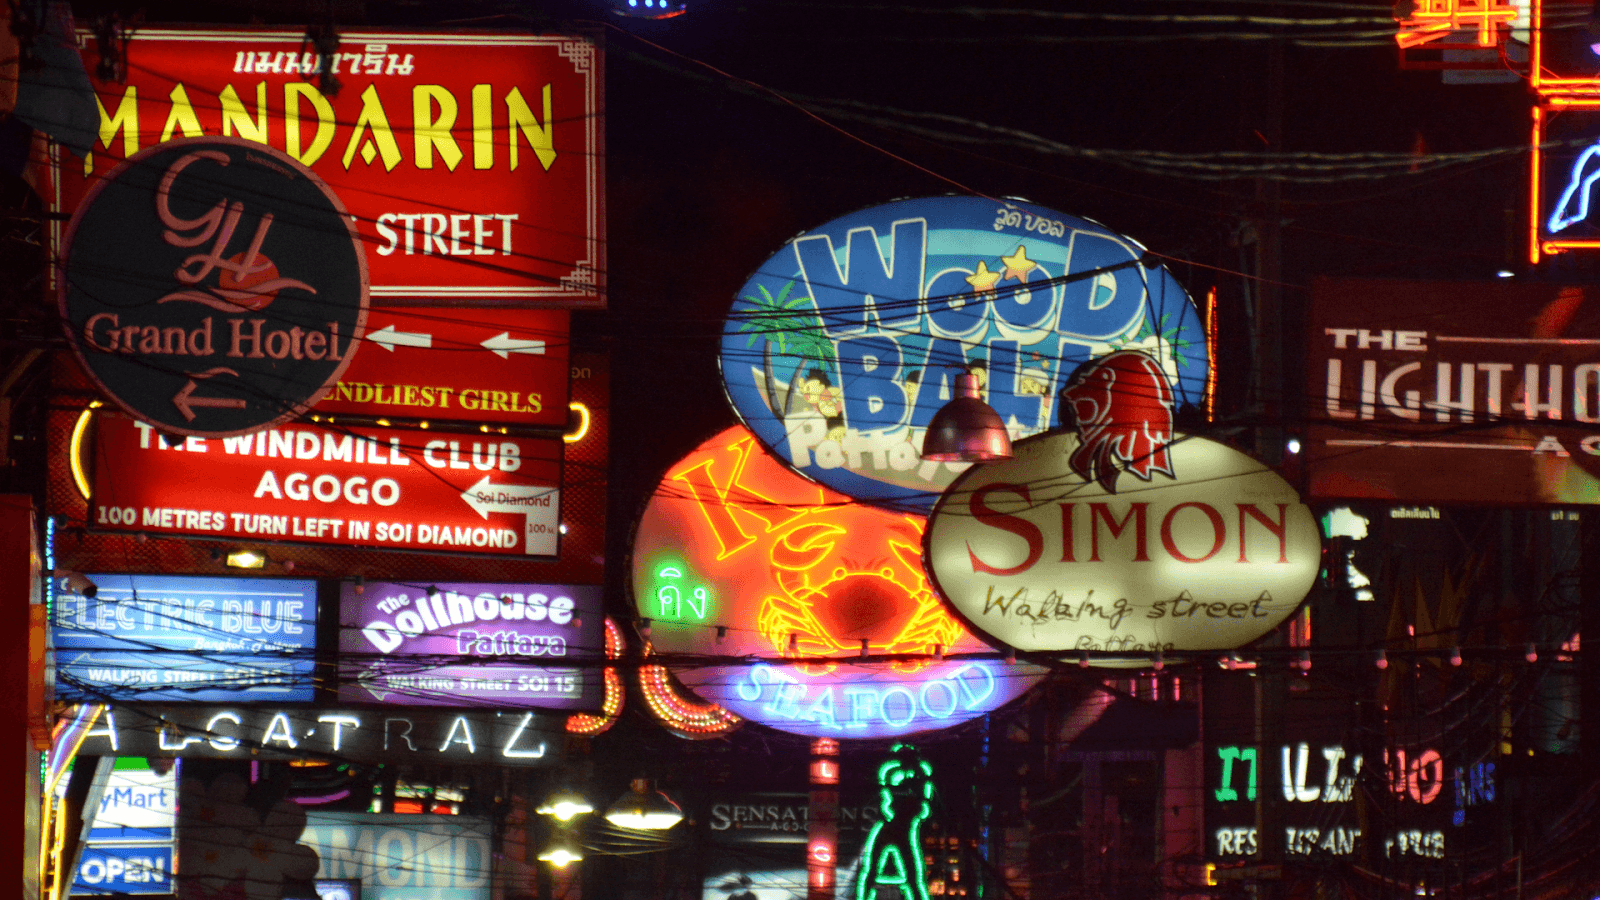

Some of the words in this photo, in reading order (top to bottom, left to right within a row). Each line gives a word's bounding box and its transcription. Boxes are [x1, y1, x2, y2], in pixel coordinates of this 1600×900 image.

[84, 81, 558, 178] MANDARIN
[375, 213, 519, 256] STREET
[793, 217, 1148, 346] WOOD
[83, 313, 215, 357] Grand
[226, 318, 343, 362] Hotel
[1325, 328, 1428, 351] THE
[458, 391, 543, 414] GIRLS
[223, 429, 410, 466] WINDMILL
[423, 440, 521, 472] CLUB
[253, 470, 401, 506] AGOGO
[476, 491, 495, 504] Soi
[497, 492, 551, 508] Diamond
[98, 506, 136, 525] 100
[142, 508, 225, 531] METRES
[230, 512, 288, 535] TURN
[292, 517, 343, 539] LEFT
[348, 520, 370, 540] IN
[374, 521, 412, 543] SOI
[417, 524, 518, 549] DIAMOND
[529, 523, 546, 534] 100
[964, 482, 1291, 577] SIMON
[376, 593, 410, 615] The
[658, 566, 706, 620] คิง
[982, 584, 1134, 630] Walking
[1146, 589, 1273, 619] street
[56, 595, 215, 632] ELECTRIC
[221, 599, 304, 634] BLUE
[361, 591, 575, 654] Dollhouse
[456, 629, 567, 657] Pattaya
[88, 668, 157, 683] WALKING
[163, 669, 215, 683] STREET
[385, 675, 454, 690] WALKING
[460, 677, 512, 691] STREET
[517, 676, 550, 692] SOI
[554, 677, 575, 692] 15
[738, 662, 996, 730] SEAFOOD
[86, 706, 546, 758] ALCATRAZ
[710, 804, 880, 831] SENSATNS
[80, 855, 166, 885] OPEN
